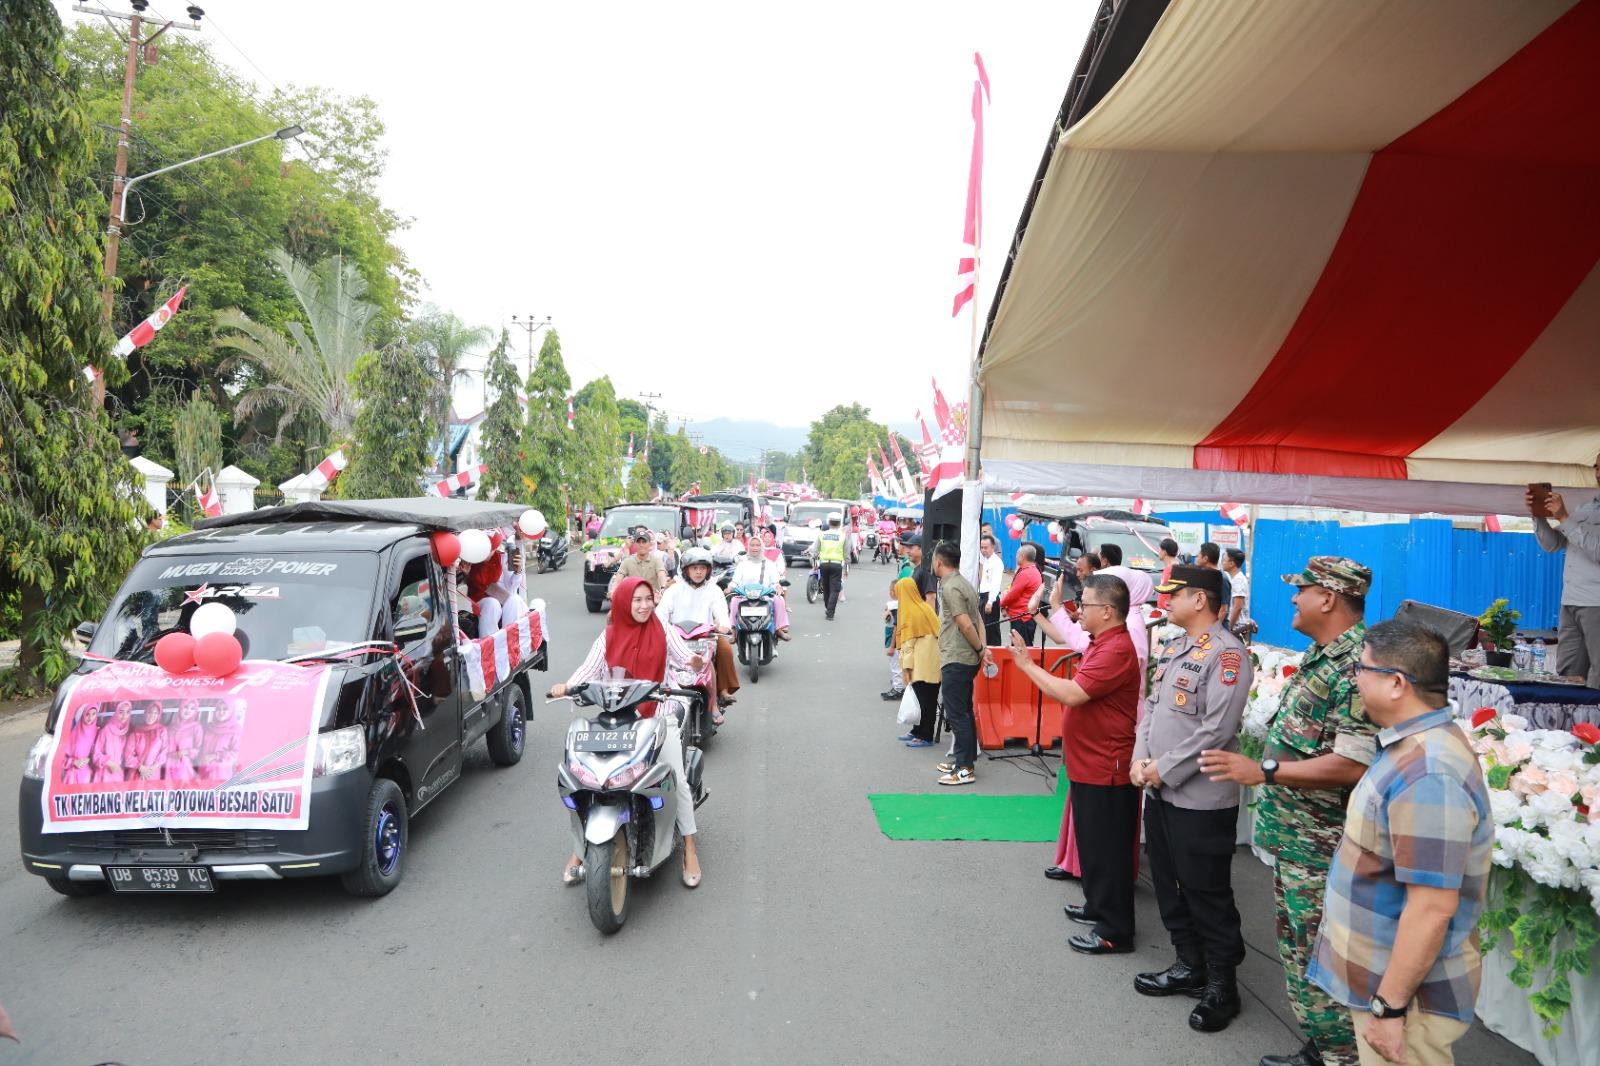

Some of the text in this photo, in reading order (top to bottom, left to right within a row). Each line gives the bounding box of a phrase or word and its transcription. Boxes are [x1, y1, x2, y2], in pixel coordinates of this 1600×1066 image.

[158, 561, 338, 579] MUGEN POWER
[1181, 661, 1203, 673] POLRI
[576, 732, 589, 741] DB
[594, 732, 618, 741] 4122
[55, 796, 68, 816] TK
[71, 793, 121, 815] KEMBANG
[169, 791, 215, 812] POYOWA
[220, 791, 258, 812] BESAR
[261, 792, 293, 813] SATU
[112, 868, 208, 882] DB 8539 KC
